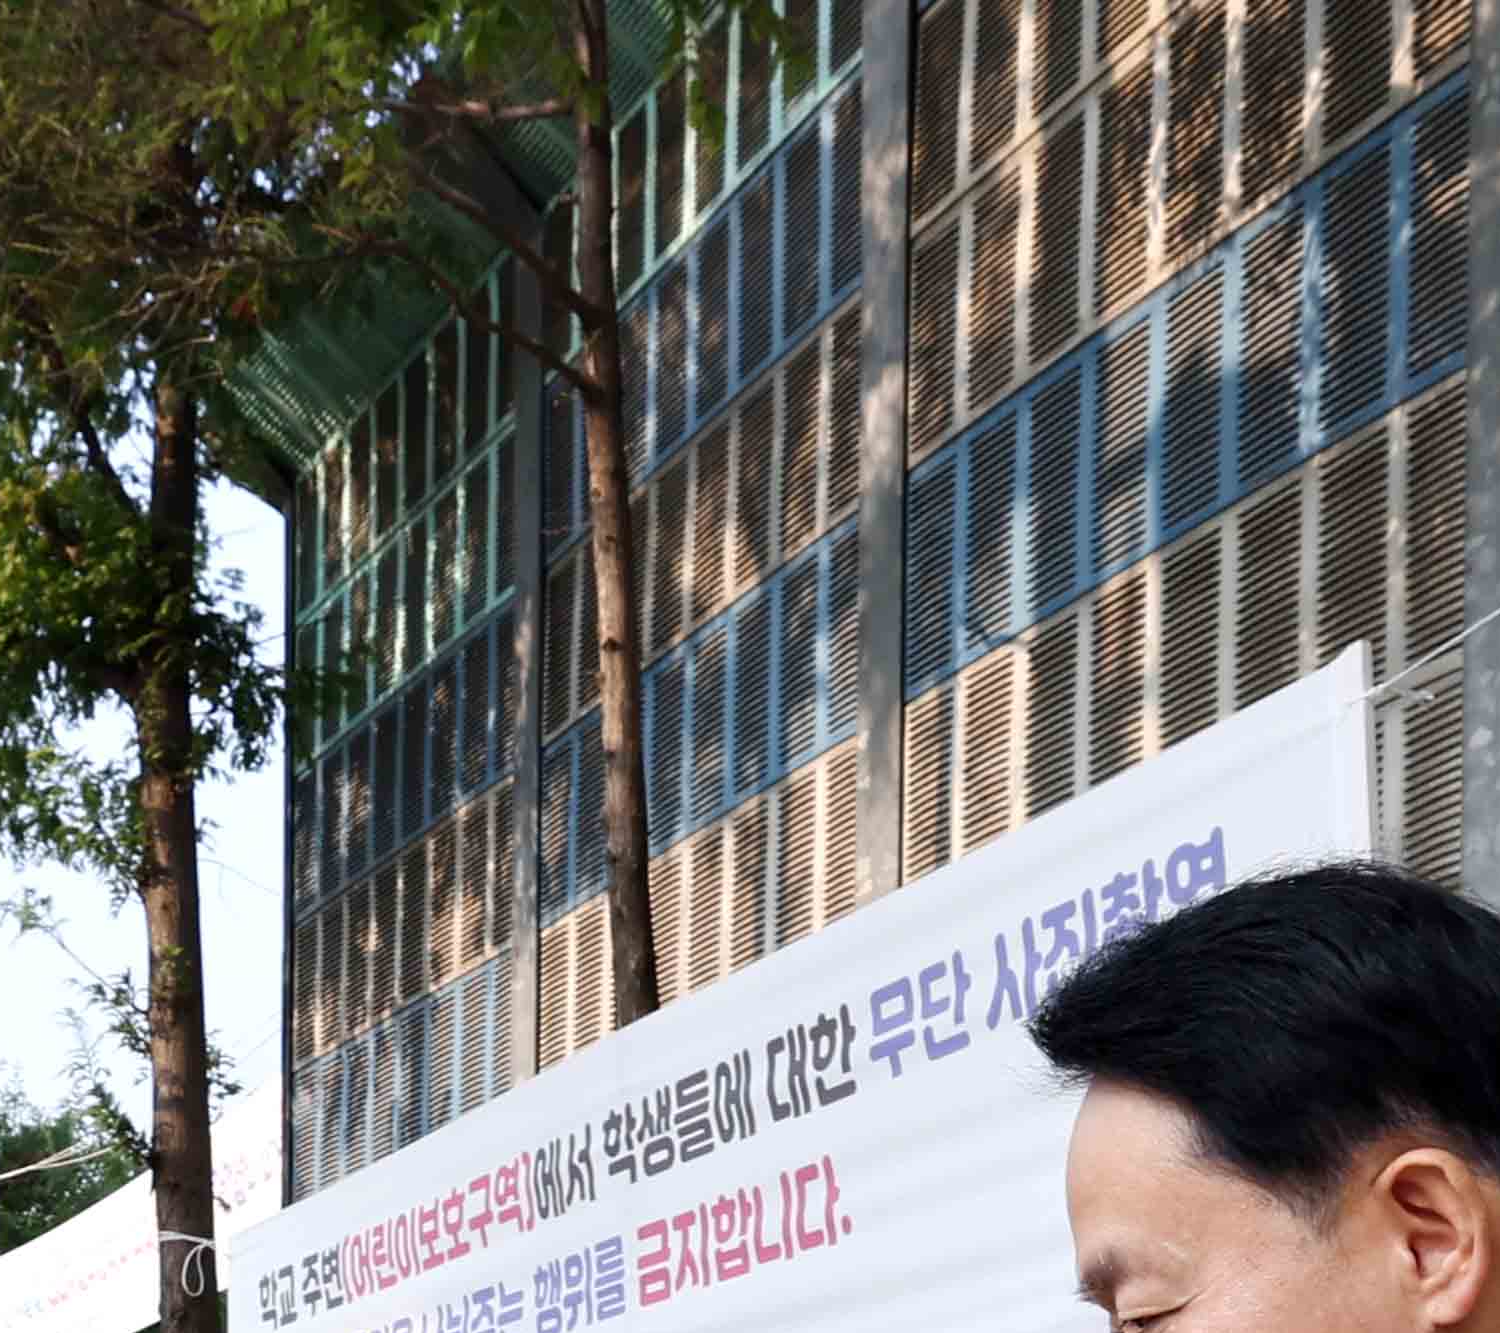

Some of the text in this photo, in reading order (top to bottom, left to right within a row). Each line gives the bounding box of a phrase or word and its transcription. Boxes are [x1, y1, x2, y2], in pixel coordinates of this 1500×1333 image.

[259, 1264, 299, 1330] 학교
[603, 1048, 757, 1184] 학생들에
[766, 1003, 857, 1122] 대한
[868, 948, 972, 1079] 무단
[636, 1153, 853, 1308] 금지합니다.
